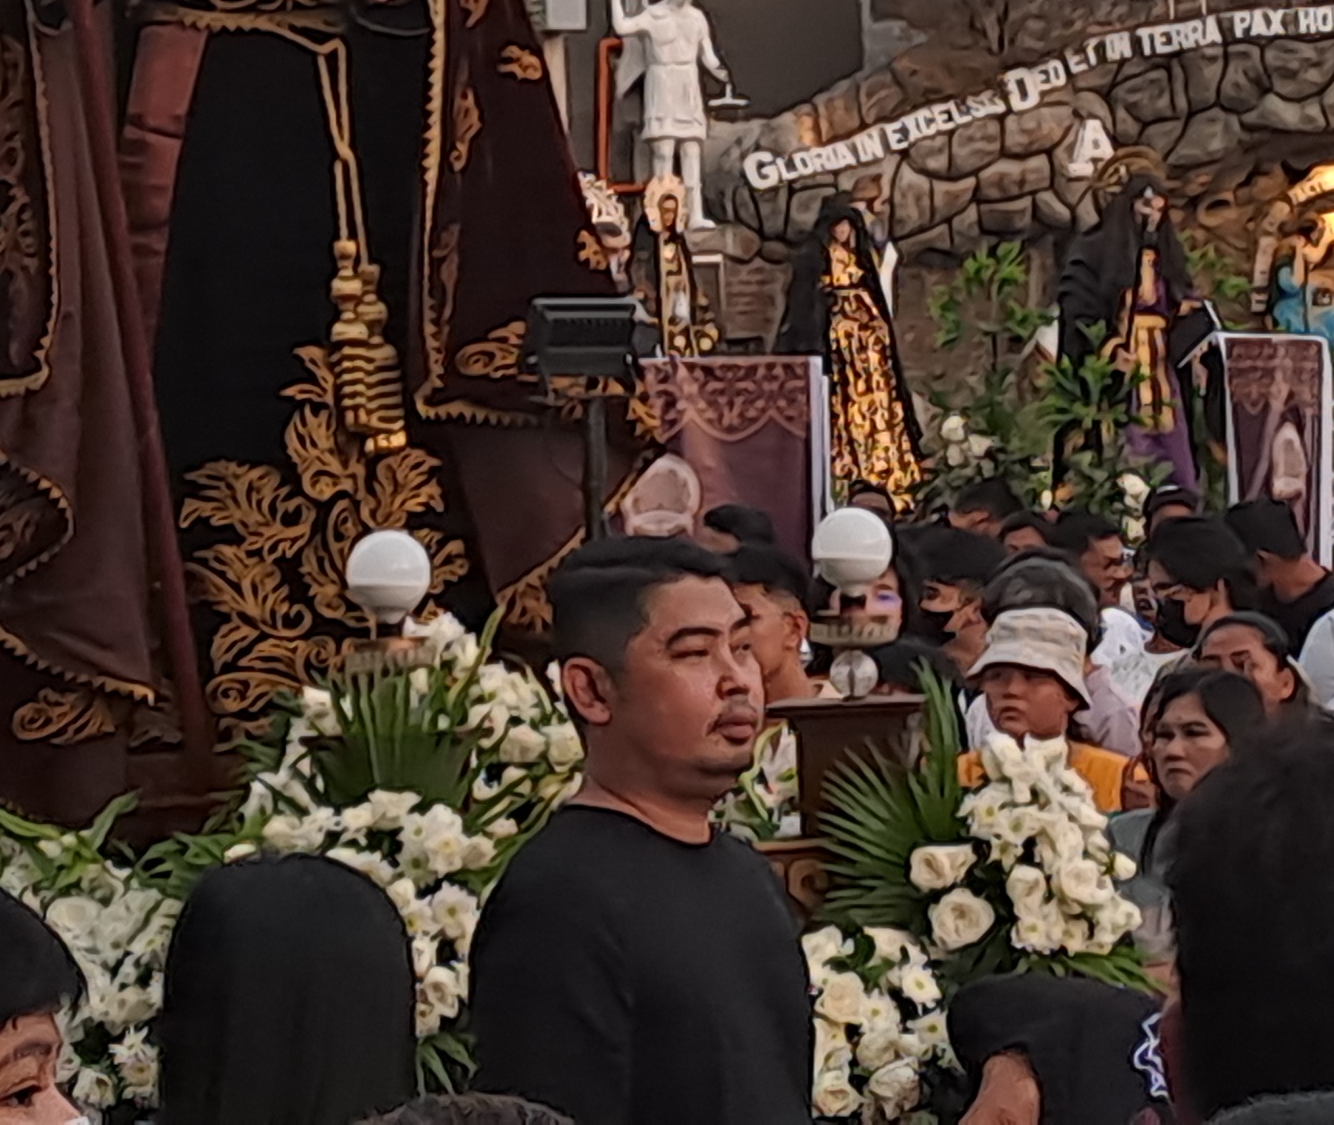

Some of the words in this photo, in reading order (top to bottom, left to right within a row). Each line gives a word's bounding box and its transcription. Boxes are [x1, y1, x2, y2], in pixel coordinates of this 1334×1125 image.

[743, 139, 857, 190] GLORIA
[850, 130, 885, 163] IN
[1004, 59, 1067, 112] DEO
[1063, 36, 1105, 74] ET
[1104, 31, 1133, 63] IN
[1135, 14, 1223, 57] TERRA
[1232, 8, 1287, 39] PAX
